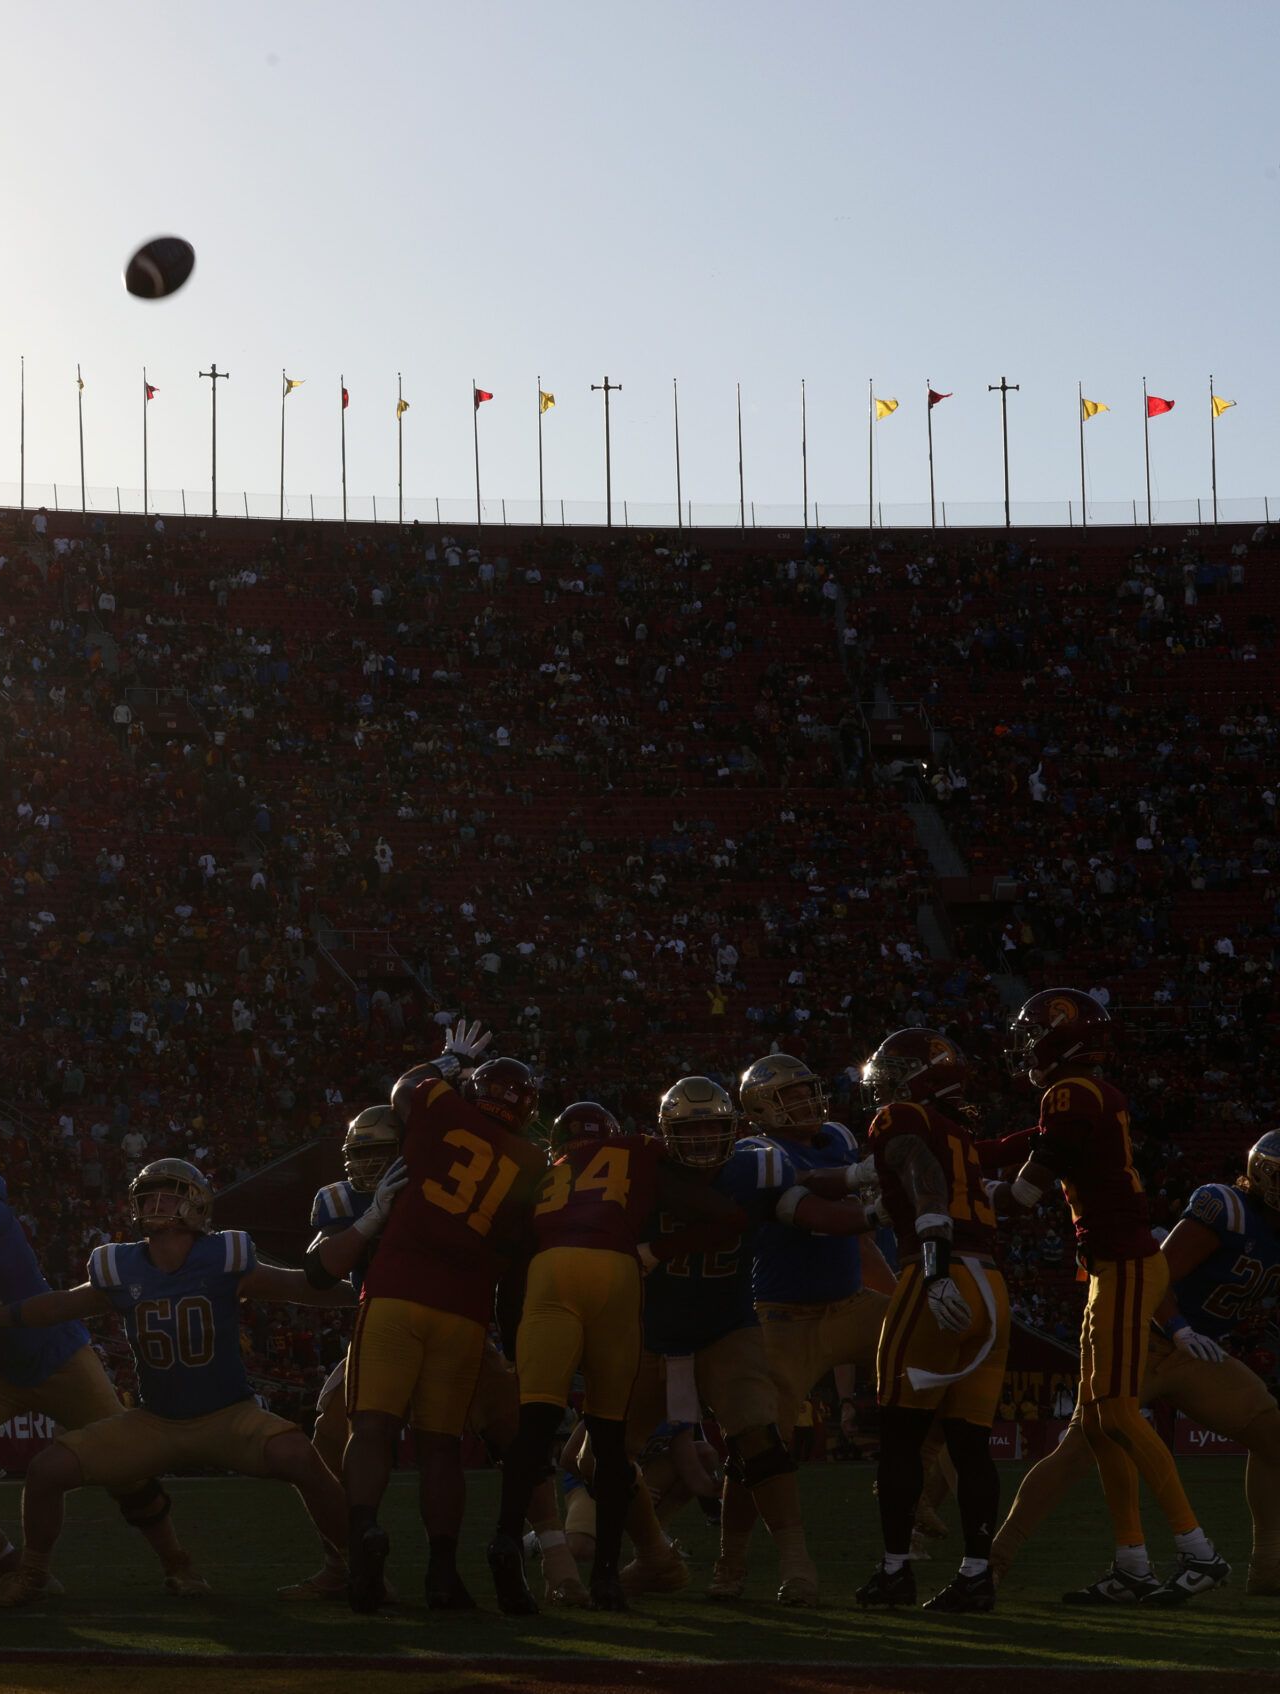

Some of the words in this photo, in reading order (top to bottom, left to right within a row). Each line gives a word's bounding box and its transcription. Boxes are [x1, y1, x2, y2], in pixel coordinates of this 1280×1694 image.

[1046, 1087, 1070, 1114] 18
[421, 1128, 519, 1237] 31
[534, 1146, 631, 1217] 34
[1191, 1191, 1224, 1224] 20
[135, 1295, 216, 1371] 60
[987, 1436, 1011, 1446] ITAL
